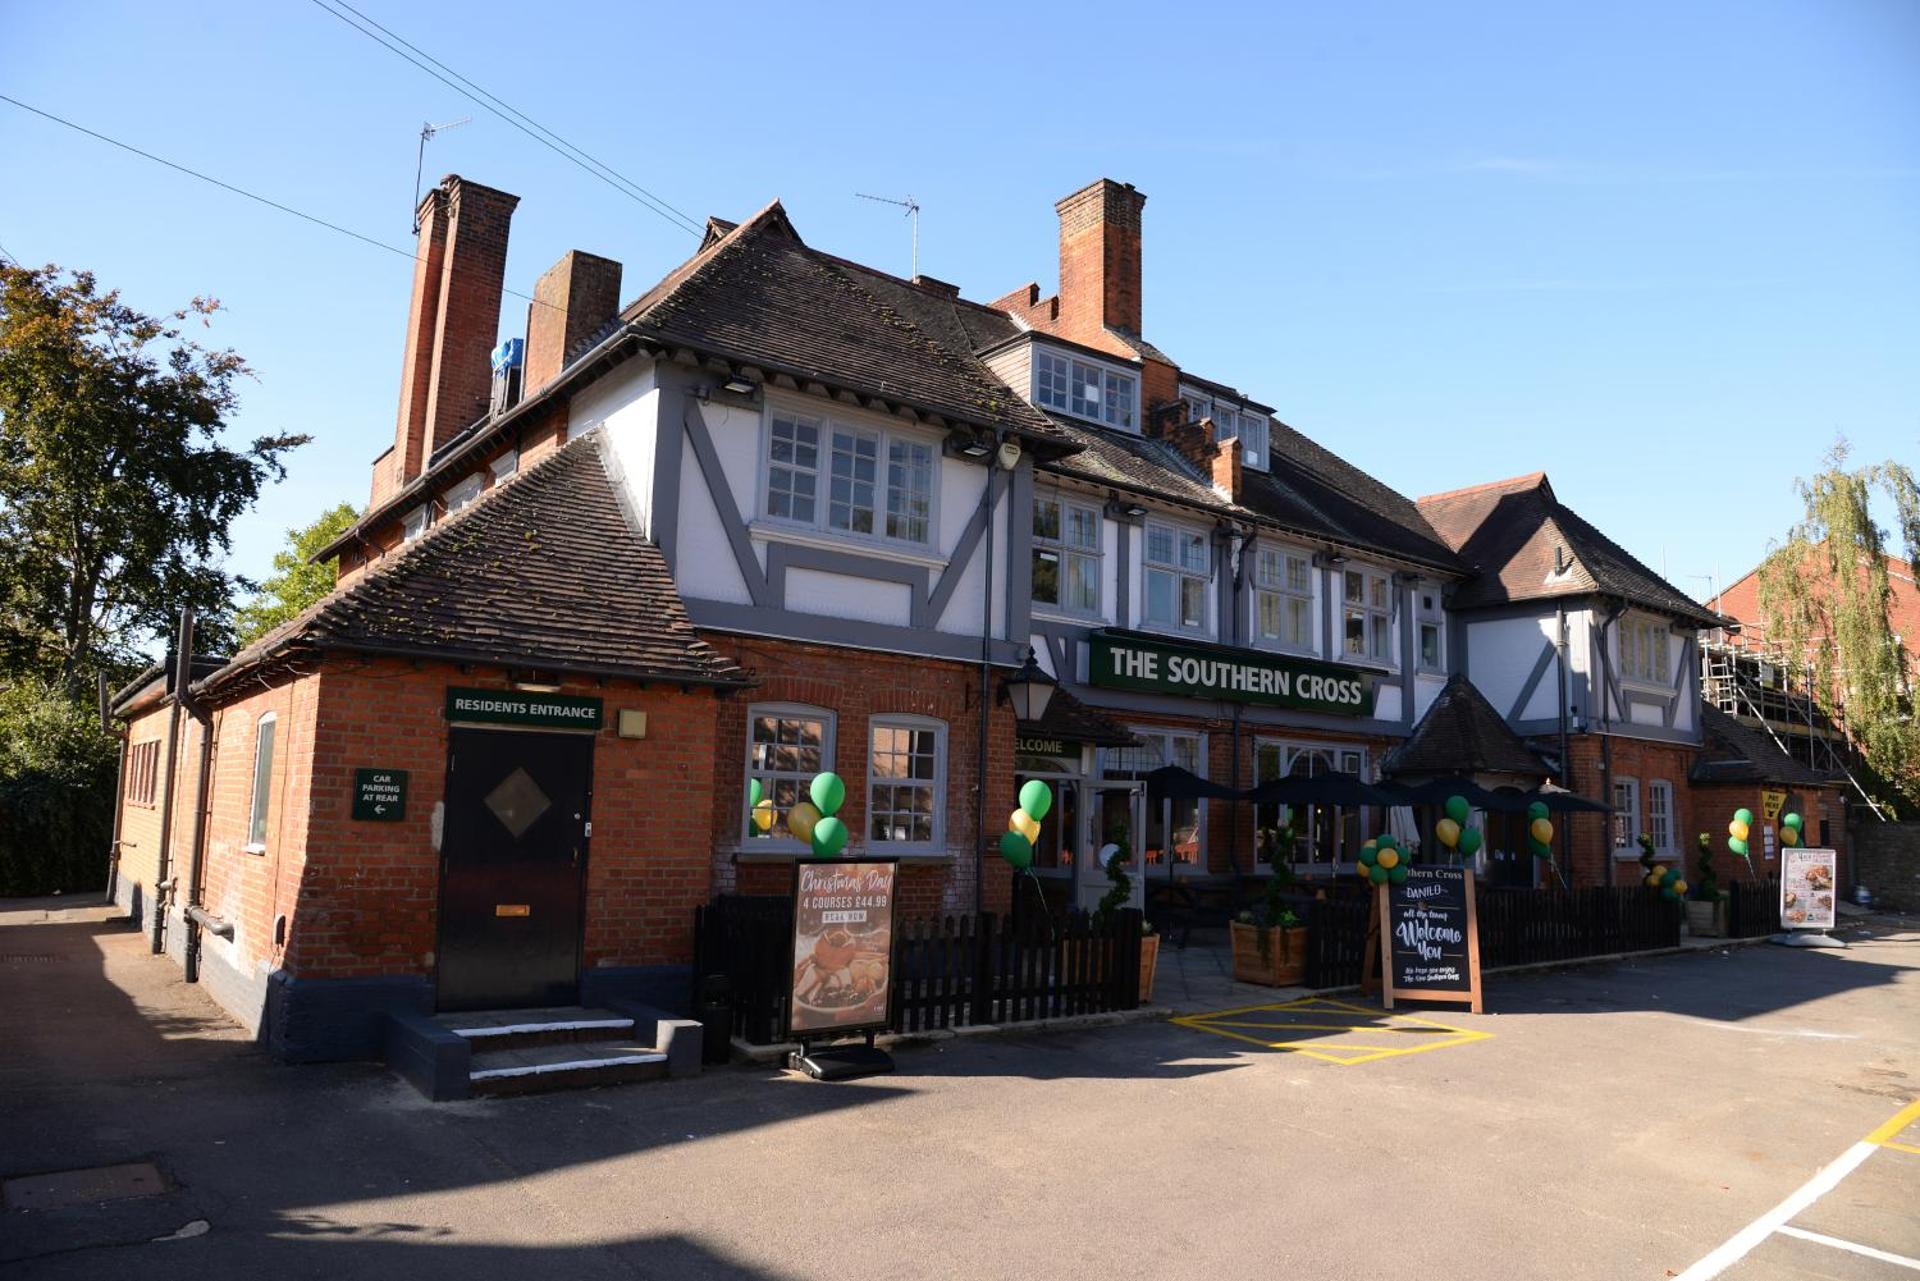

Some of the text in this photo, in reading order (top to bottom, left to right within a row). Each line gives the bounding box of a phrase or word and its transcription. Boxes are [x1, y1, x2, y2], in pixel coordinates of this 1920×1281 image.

[1110, 647, 1362, 705] THE SOUTHERN CROSS
[455, 698, 596, 719] RESIDENTS ENTRANCE
[1015, 738, 1063, 753] ELCOME
[373, 775, 391, 783] CAR
[362, 784, 400, 793] PARKING
[376, 794, 398, 802] REAR
[1435, 869, 1463, 879] Cross
[801, 868, 893, 896] Christmas Day
[1406, 884, 1441, 898] DANILO
[803, 897, 809, 909] 4
[812, 896, 852, 909] COURSES
[1396, 918, 1462, 947] Welcome
[1417, 940, 1442, 960] You
